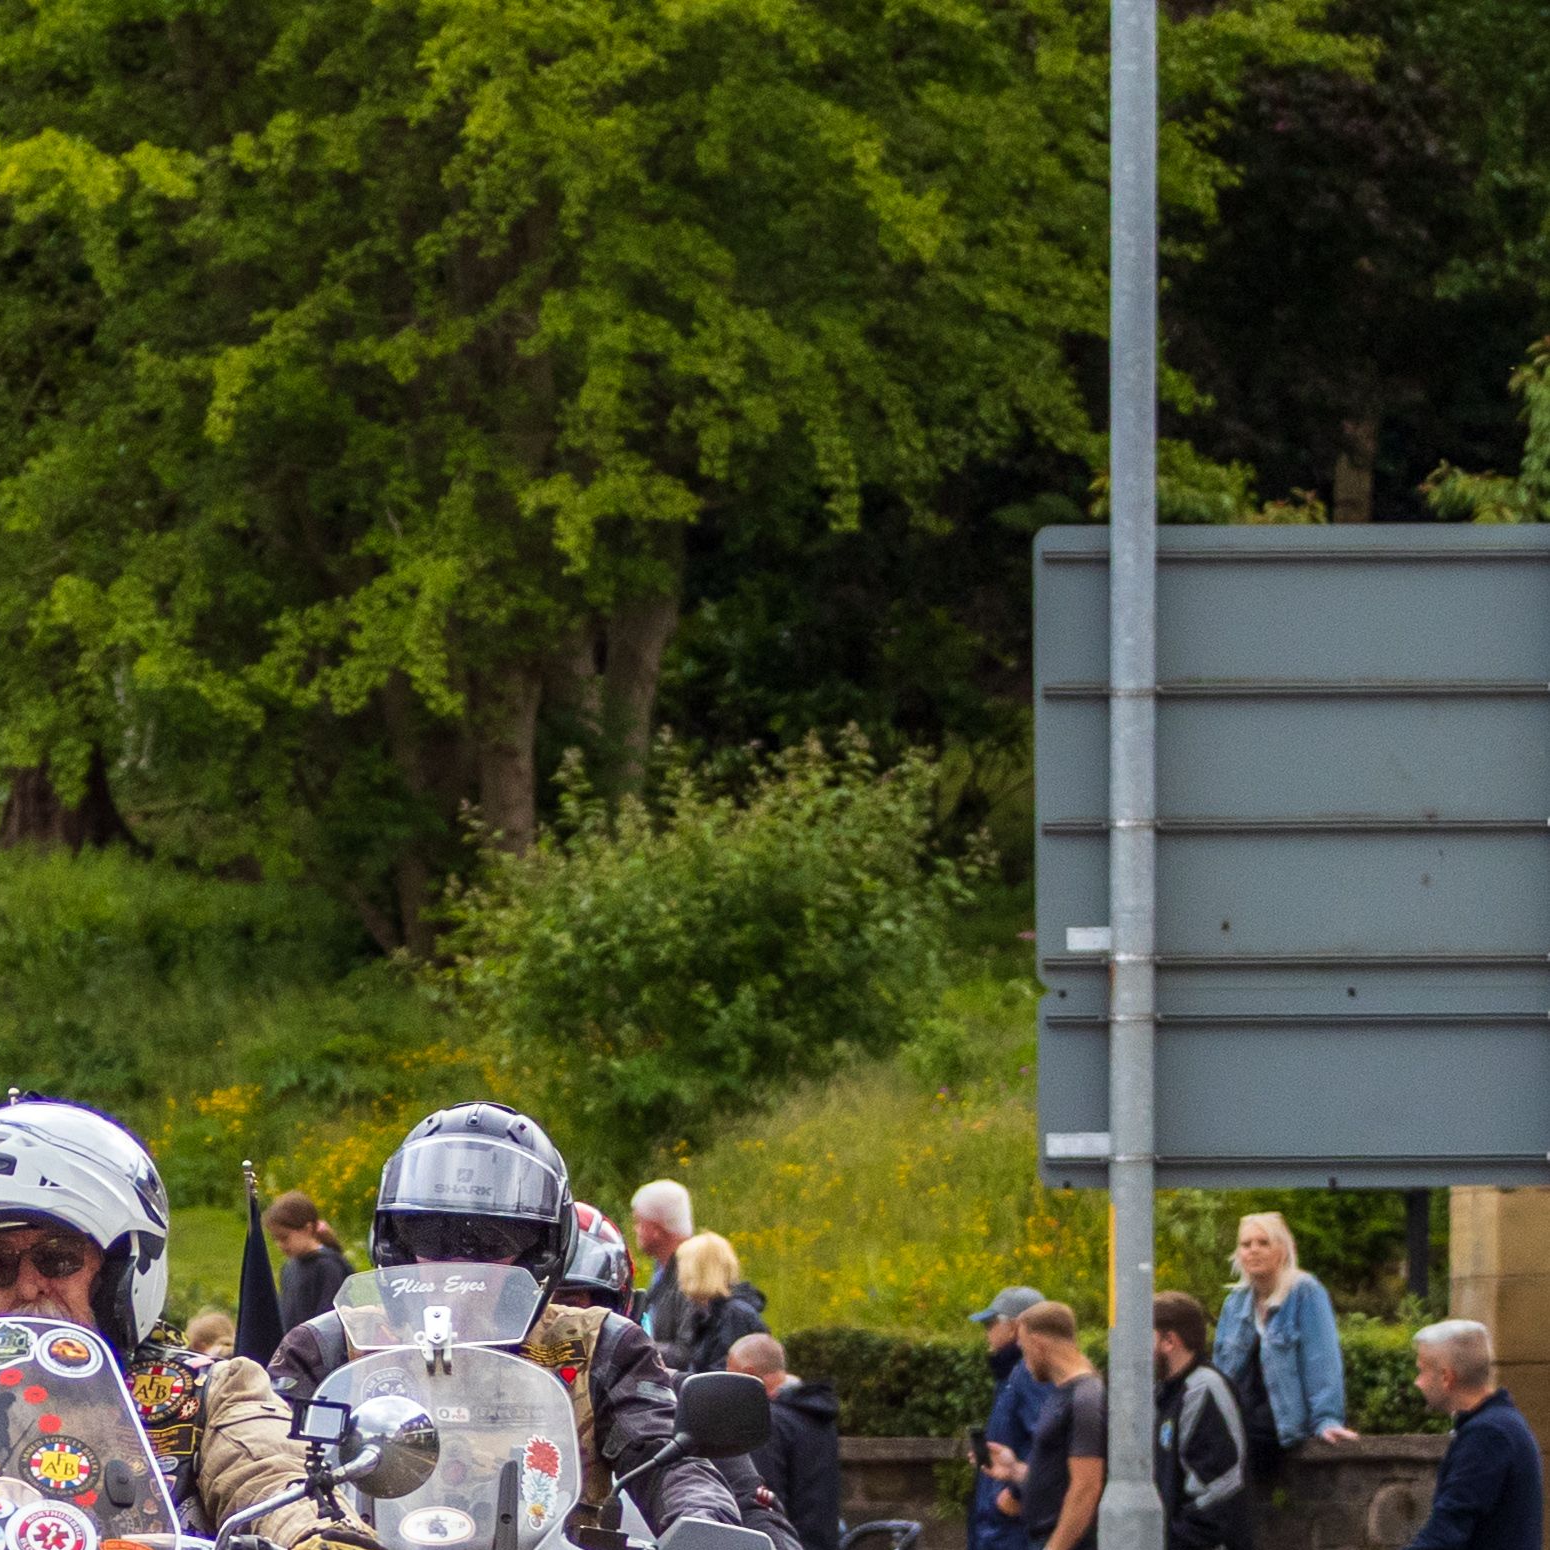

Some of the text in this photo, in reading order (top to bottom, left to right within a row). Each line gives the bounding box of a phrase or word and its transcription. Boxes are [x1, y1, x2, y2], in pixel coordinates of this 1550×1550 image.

[433, 1183, 493, 1197] SHARK
[390, 1274, 487, 1298] Flies Eyes
[26, 1510, 83, 1541] NORTHUMBRIA
